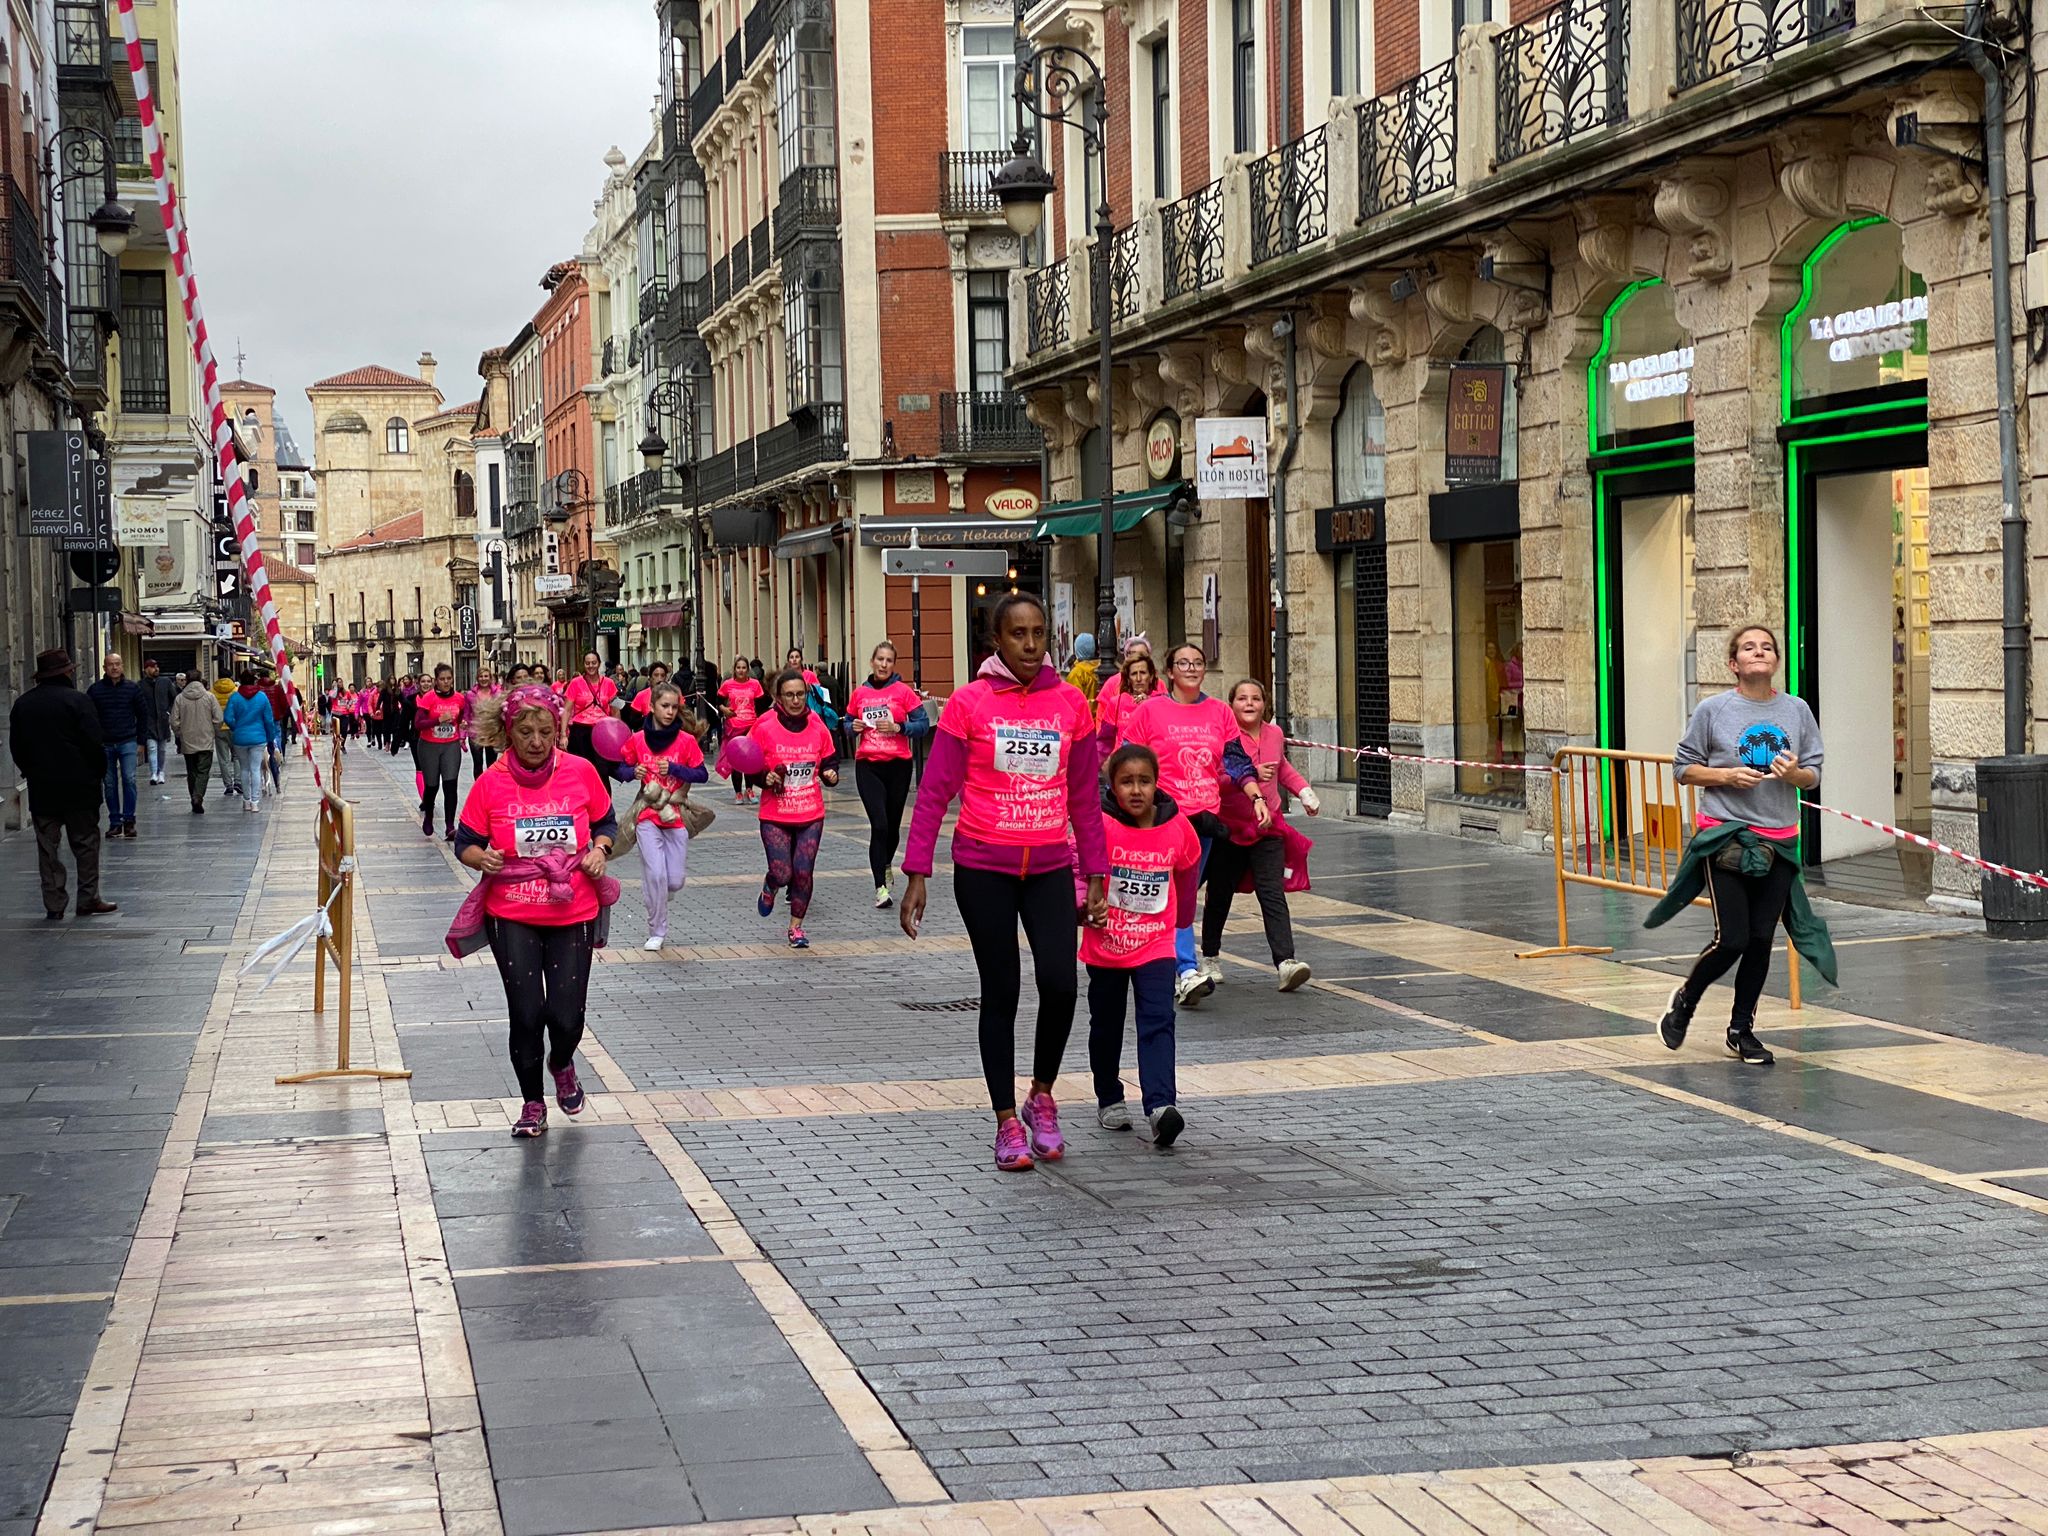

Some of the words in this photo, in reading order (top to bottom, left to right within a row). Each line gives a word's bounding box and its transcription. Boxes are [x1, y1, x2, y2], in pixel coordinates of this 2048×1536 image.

[1810, 316, 1834, 339] LA
[1834, 307, 1876, 335] CASA
[1609, 362, 1628, 383] LA
[1628, 355, 1660, 378] CASA
[1148, 437, 1173, 462] VALOR
[1199, 467, 1225, 482] LEÓN
[1229, 468, 1266, 481] HOSTEL
[992, 498, 1033, 510] VALOR
[32, 508, 65, 519] PÉREZ
[32, 525, 68, 534] BRAVO
[872, 531, 955, 543] Confería
[64, 541, 95, 550] BRAVO
[547, 534, 559, 573] IRIS
[463, 609, 472, 642] HOTEL
[866, 710, 889, 720] 0535
[993, 712, 1062, 729] Drasanvi
[1005, 741, 1051, 756] 2534
[1015, 787, 1062, 801] CARRERA
[1009, 803, 1056, 822] Mujer
[525, 828, 568, 842] 2703
[1111, 845, 1175, 864] Drasanvi
[1118, 880, 1160, 896] 2535
[1115, 920, 1167, 933] CARRERA
